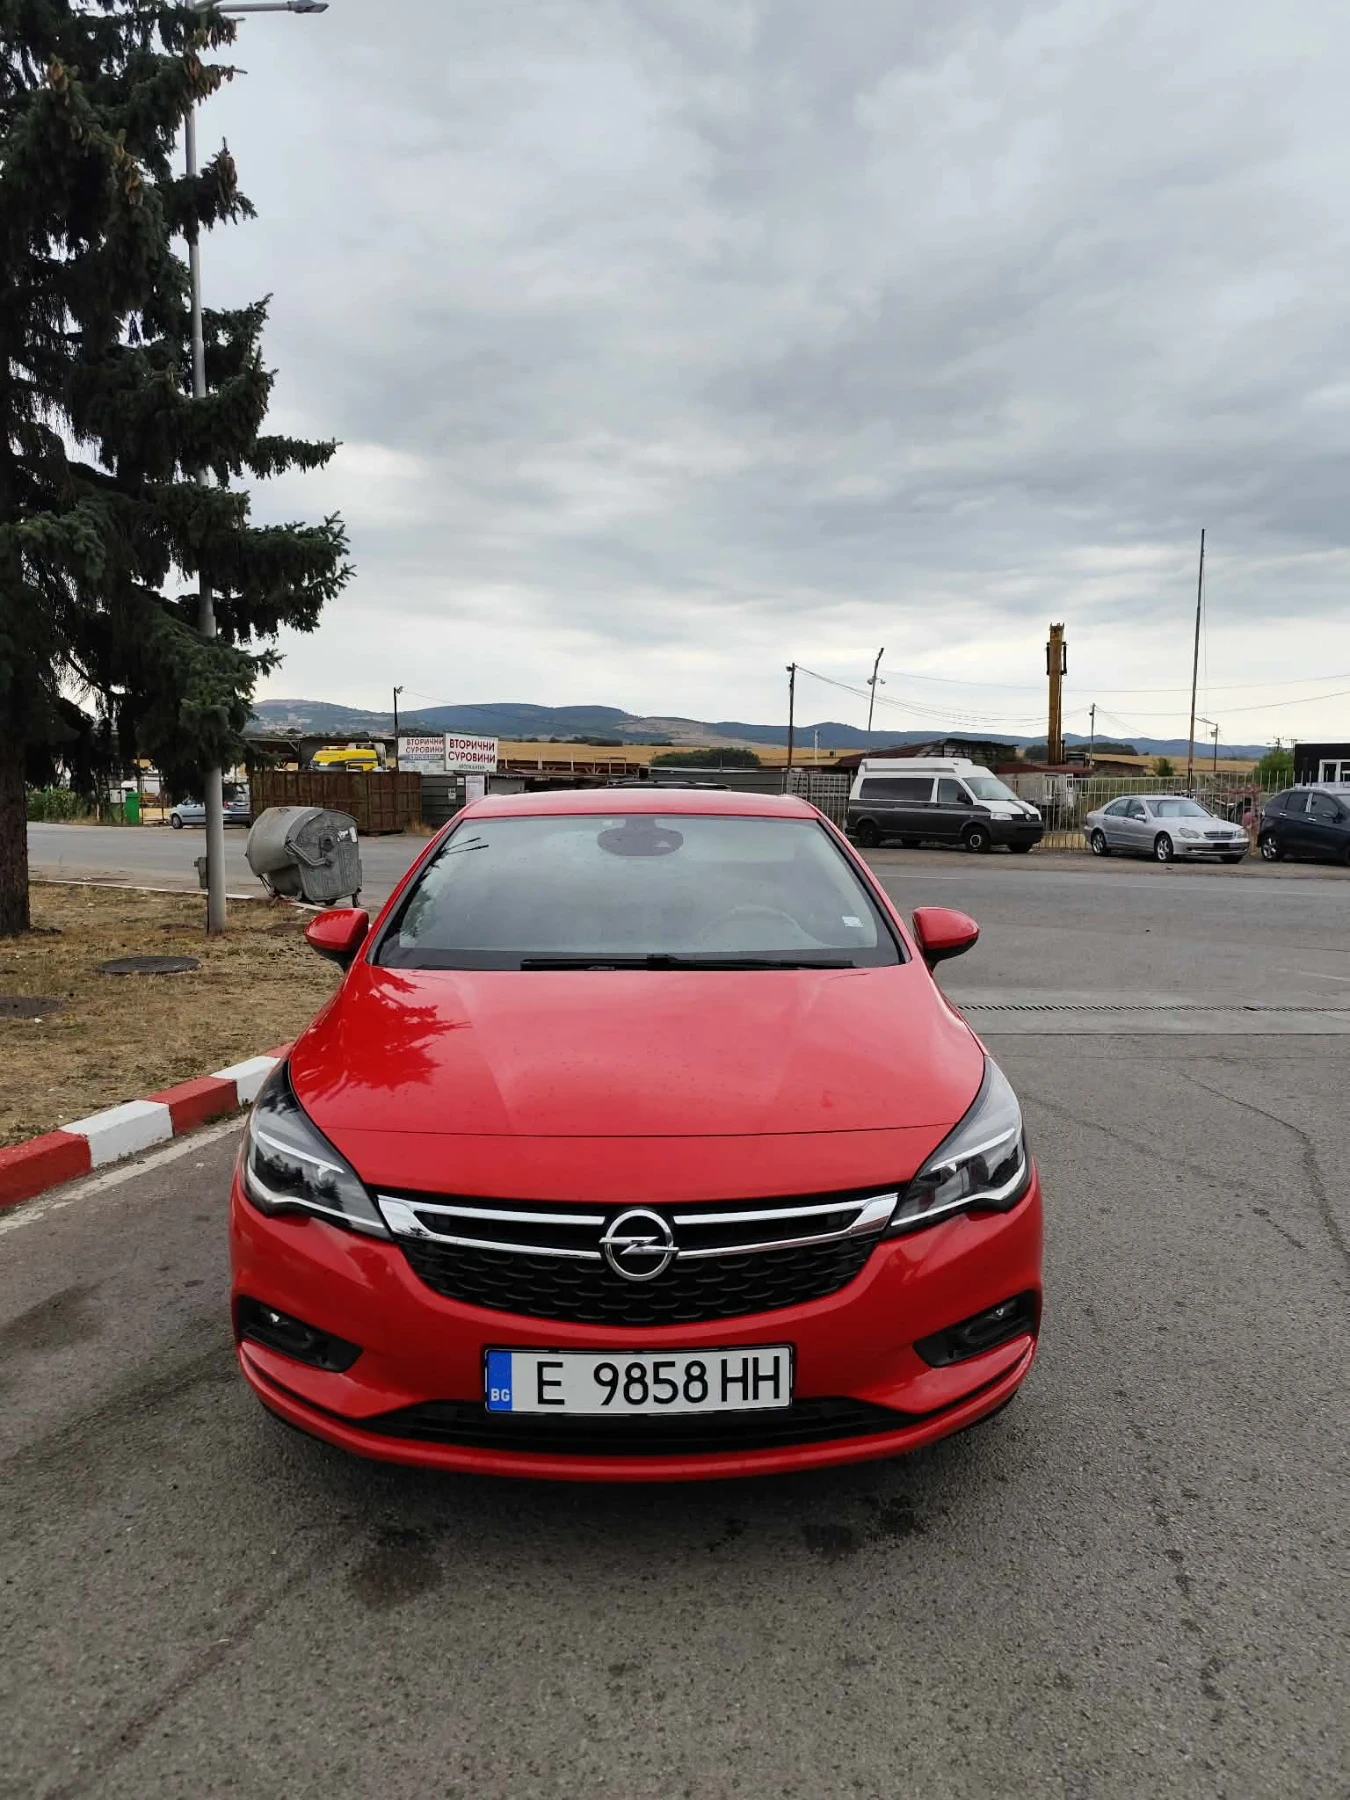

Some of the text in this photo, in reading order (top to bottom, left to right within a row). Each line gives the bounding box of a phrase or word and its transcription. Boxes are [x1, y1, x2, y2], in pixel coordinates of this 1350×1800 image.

[449, 739, 495, 752] ВТОРИЧНИ
[448, 751, 495, 763] СУРОВИНИ
[536, 1355, 780, 1406] E 9858 HH
[490, 1388, 510, 1402] BG
